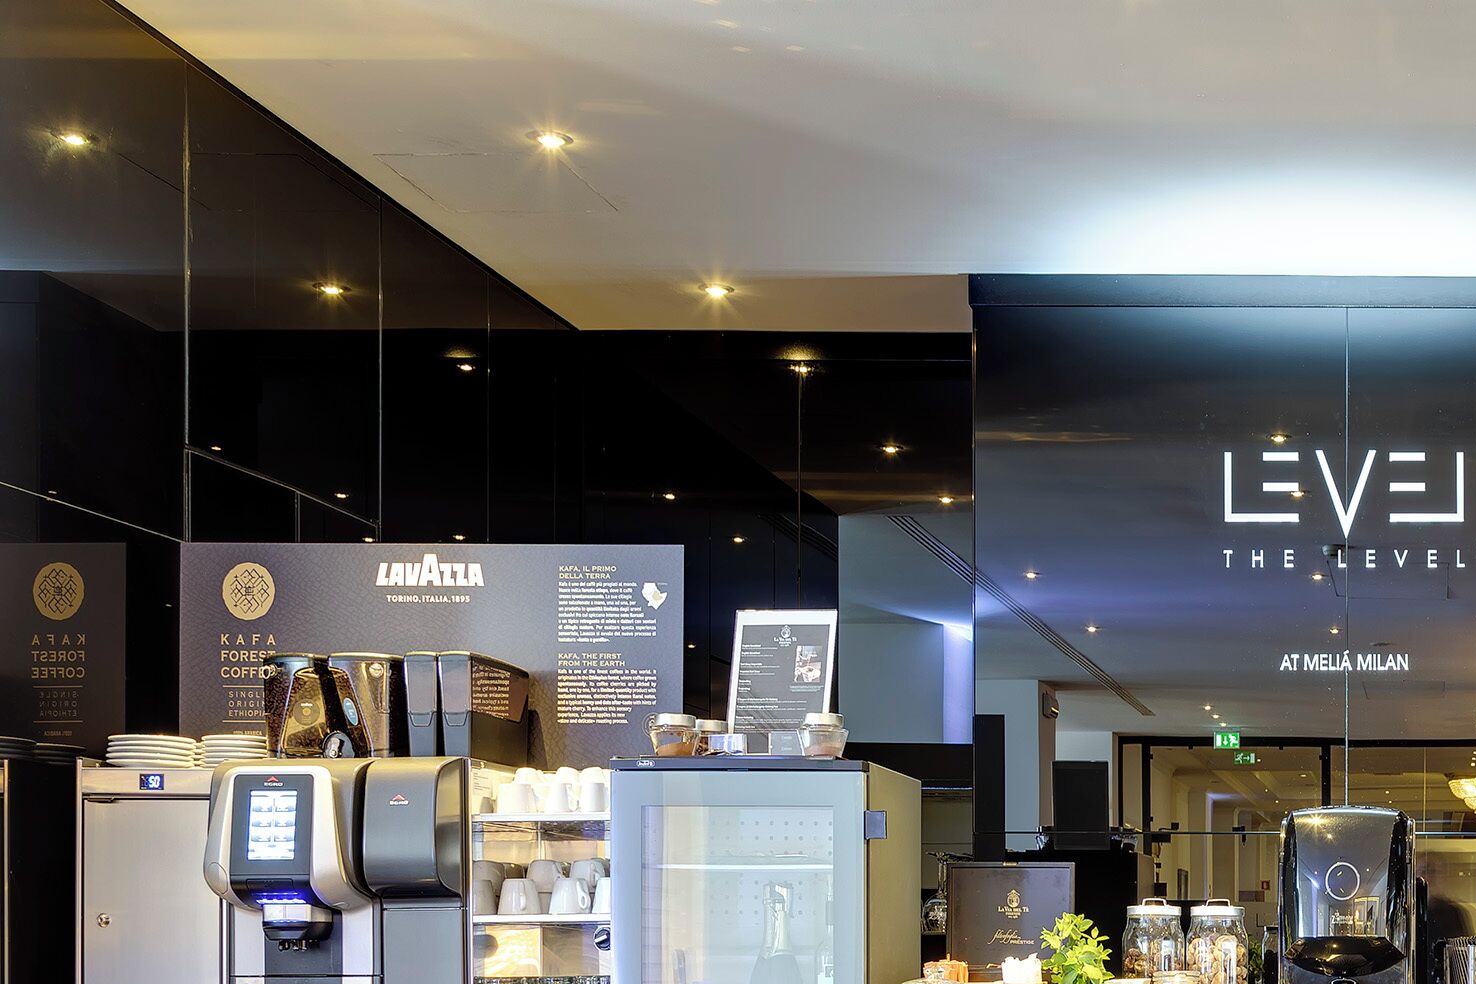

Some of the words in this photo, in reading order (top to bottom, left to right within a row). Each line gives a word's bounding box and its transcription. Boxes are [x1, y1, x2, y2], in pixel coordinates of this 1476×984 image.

[1224, 449, 1464, 538] LEVEL
[1223, 549, 1294, 568] THE
[1337, 549, 1465, 568] LEVEL
[376, 554, 484, 586] LAVAZZA
[220, 634, 276, 645] KAFA
[1280, 654, 1300, 671] AT
[1304, 650, 1352, 671] MELIÁ
[1356, 654, 1409, 671] MILAN
[220, 667, 266, 678] COFFE
